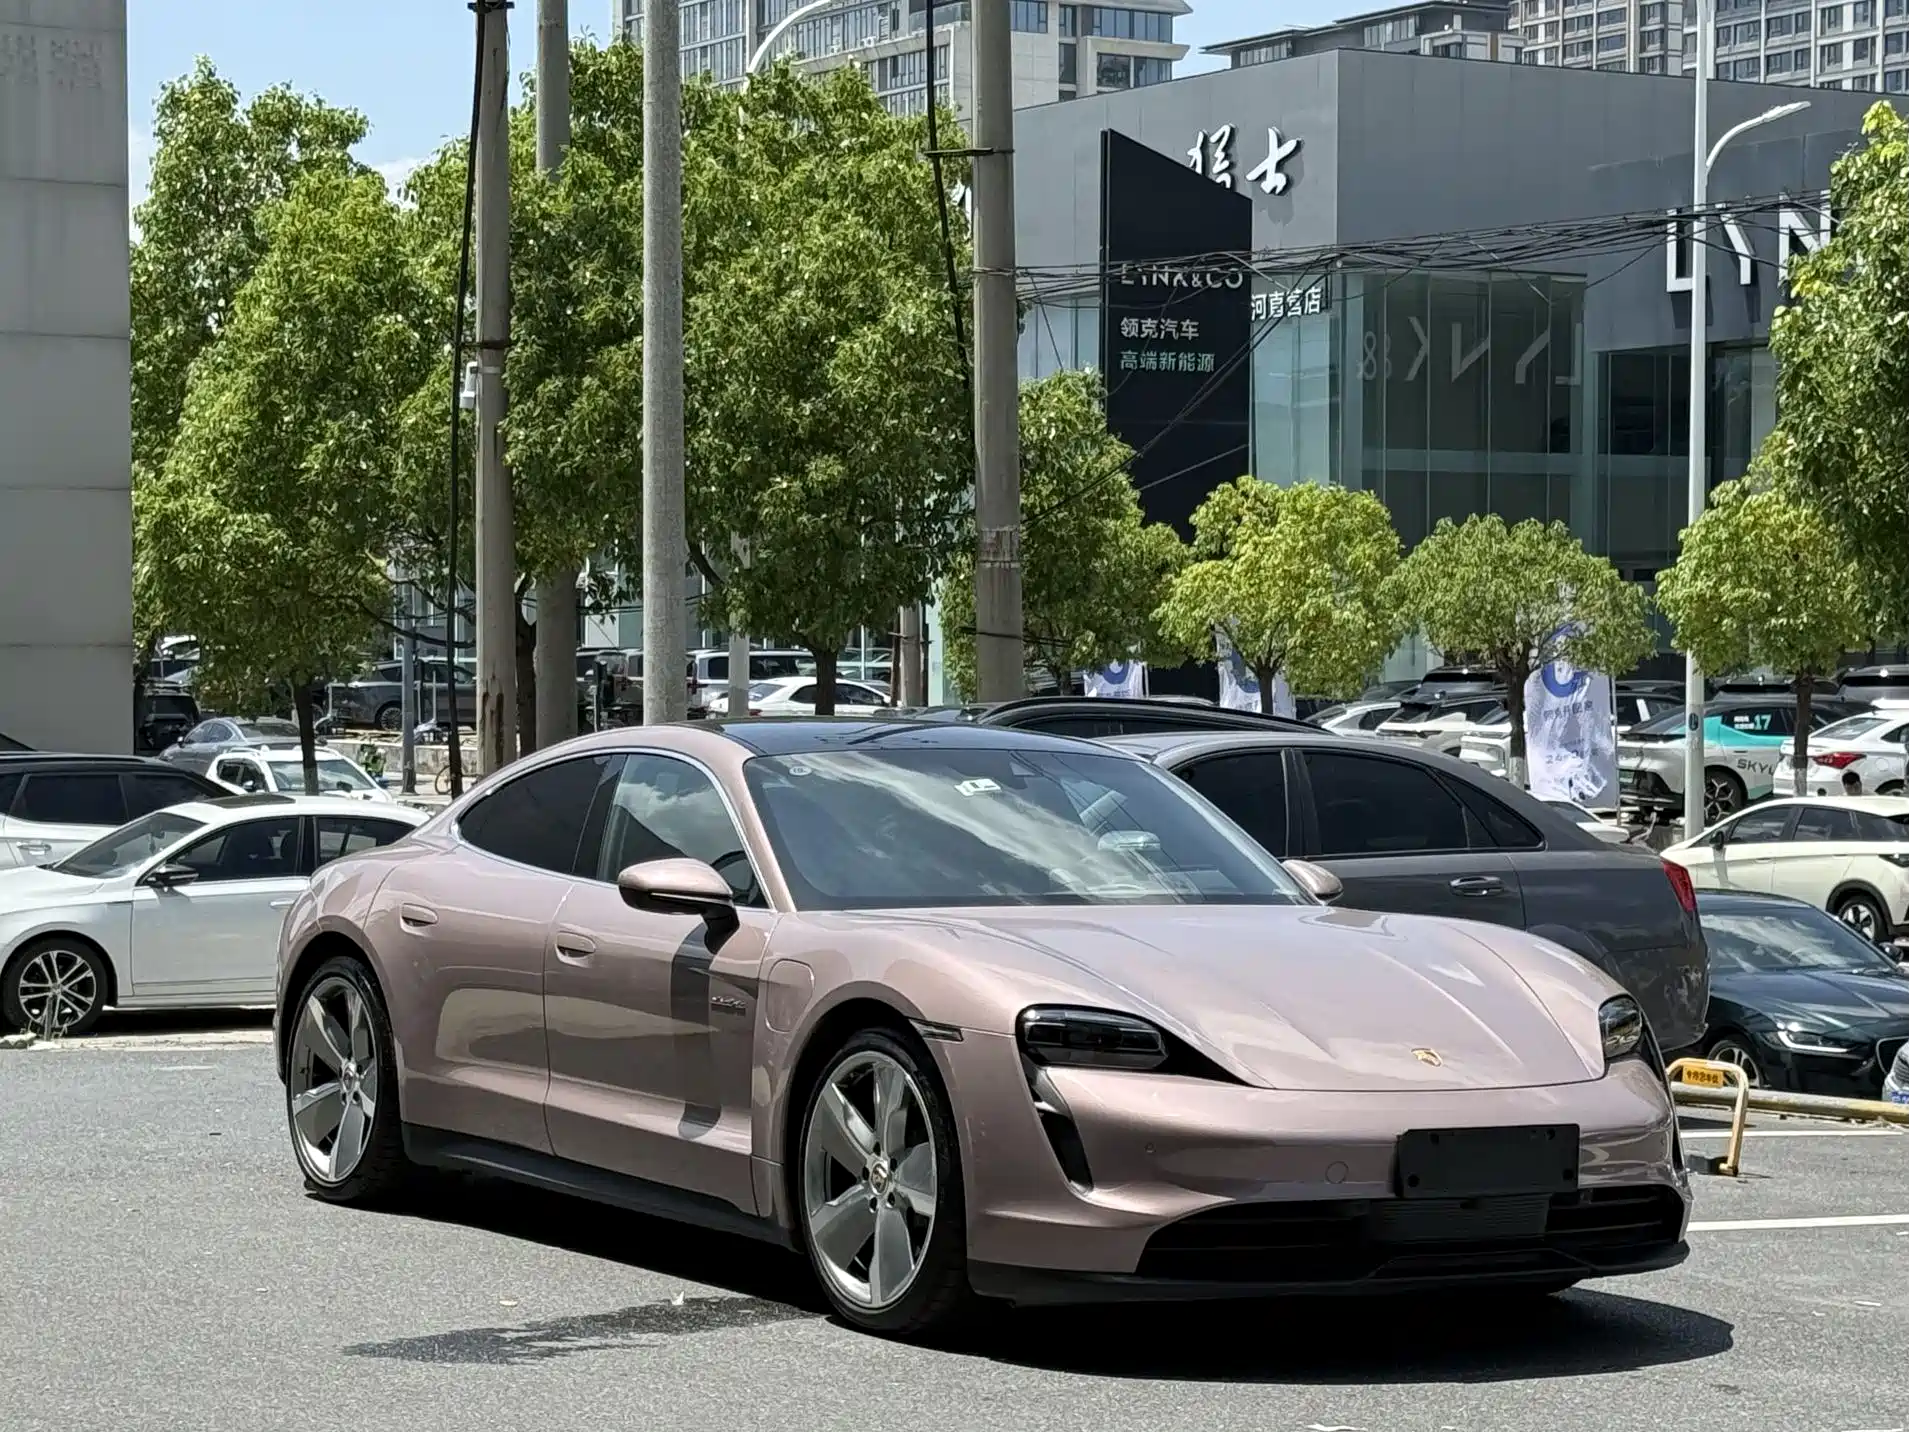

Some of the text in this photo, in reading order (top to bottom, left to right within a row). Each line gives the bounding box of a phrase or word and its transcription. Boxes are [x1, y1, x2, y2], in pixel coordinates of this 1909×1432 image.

[1120, 316, 1199, 341] 领克汽车
[1120, 350, 1215, 373] 高端新能源
